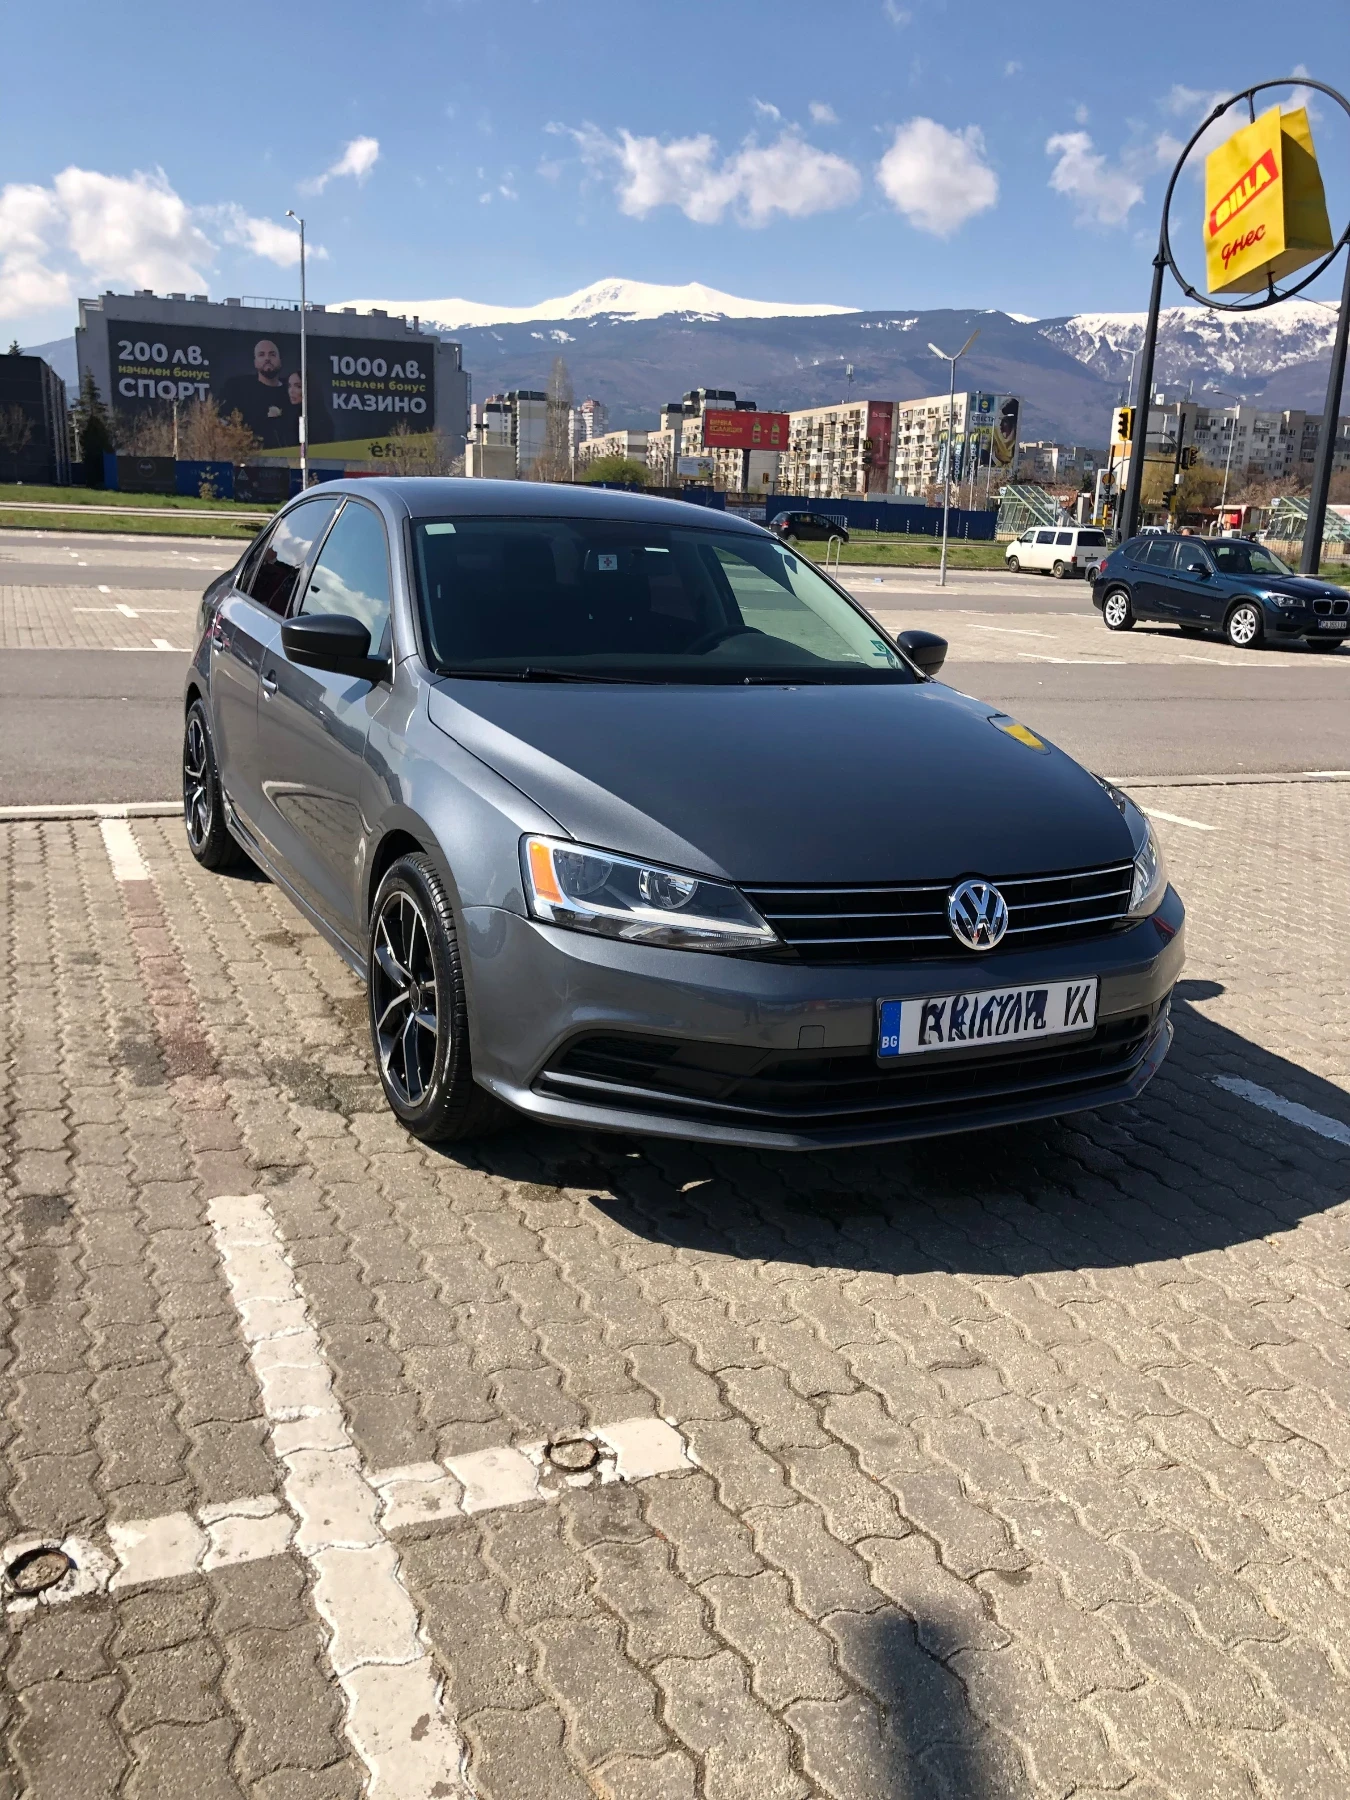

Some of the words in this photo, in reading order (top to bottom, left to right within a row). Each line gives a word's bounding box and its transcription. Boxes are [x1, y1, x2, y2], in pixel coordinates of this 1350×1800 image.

[1216, 163, 1272, 228] BILLA
[117, 340, 168, 363] 200
[171, 345, 210, 366] лв.
[118, 365, 170, 376] начален
[173, 367, 210, 380] бонус
[330, 355, 388, 377] 1000
[390, 360, 426, 380] лв.
[118, 378, 210, 401] СПОРТ
[331, 379, 385, 390] начален
[388, 381, 426, 393] бонус
[332, 393, 427, 414] КАЗИНО
[881, 1035, 898, 1048] BG
